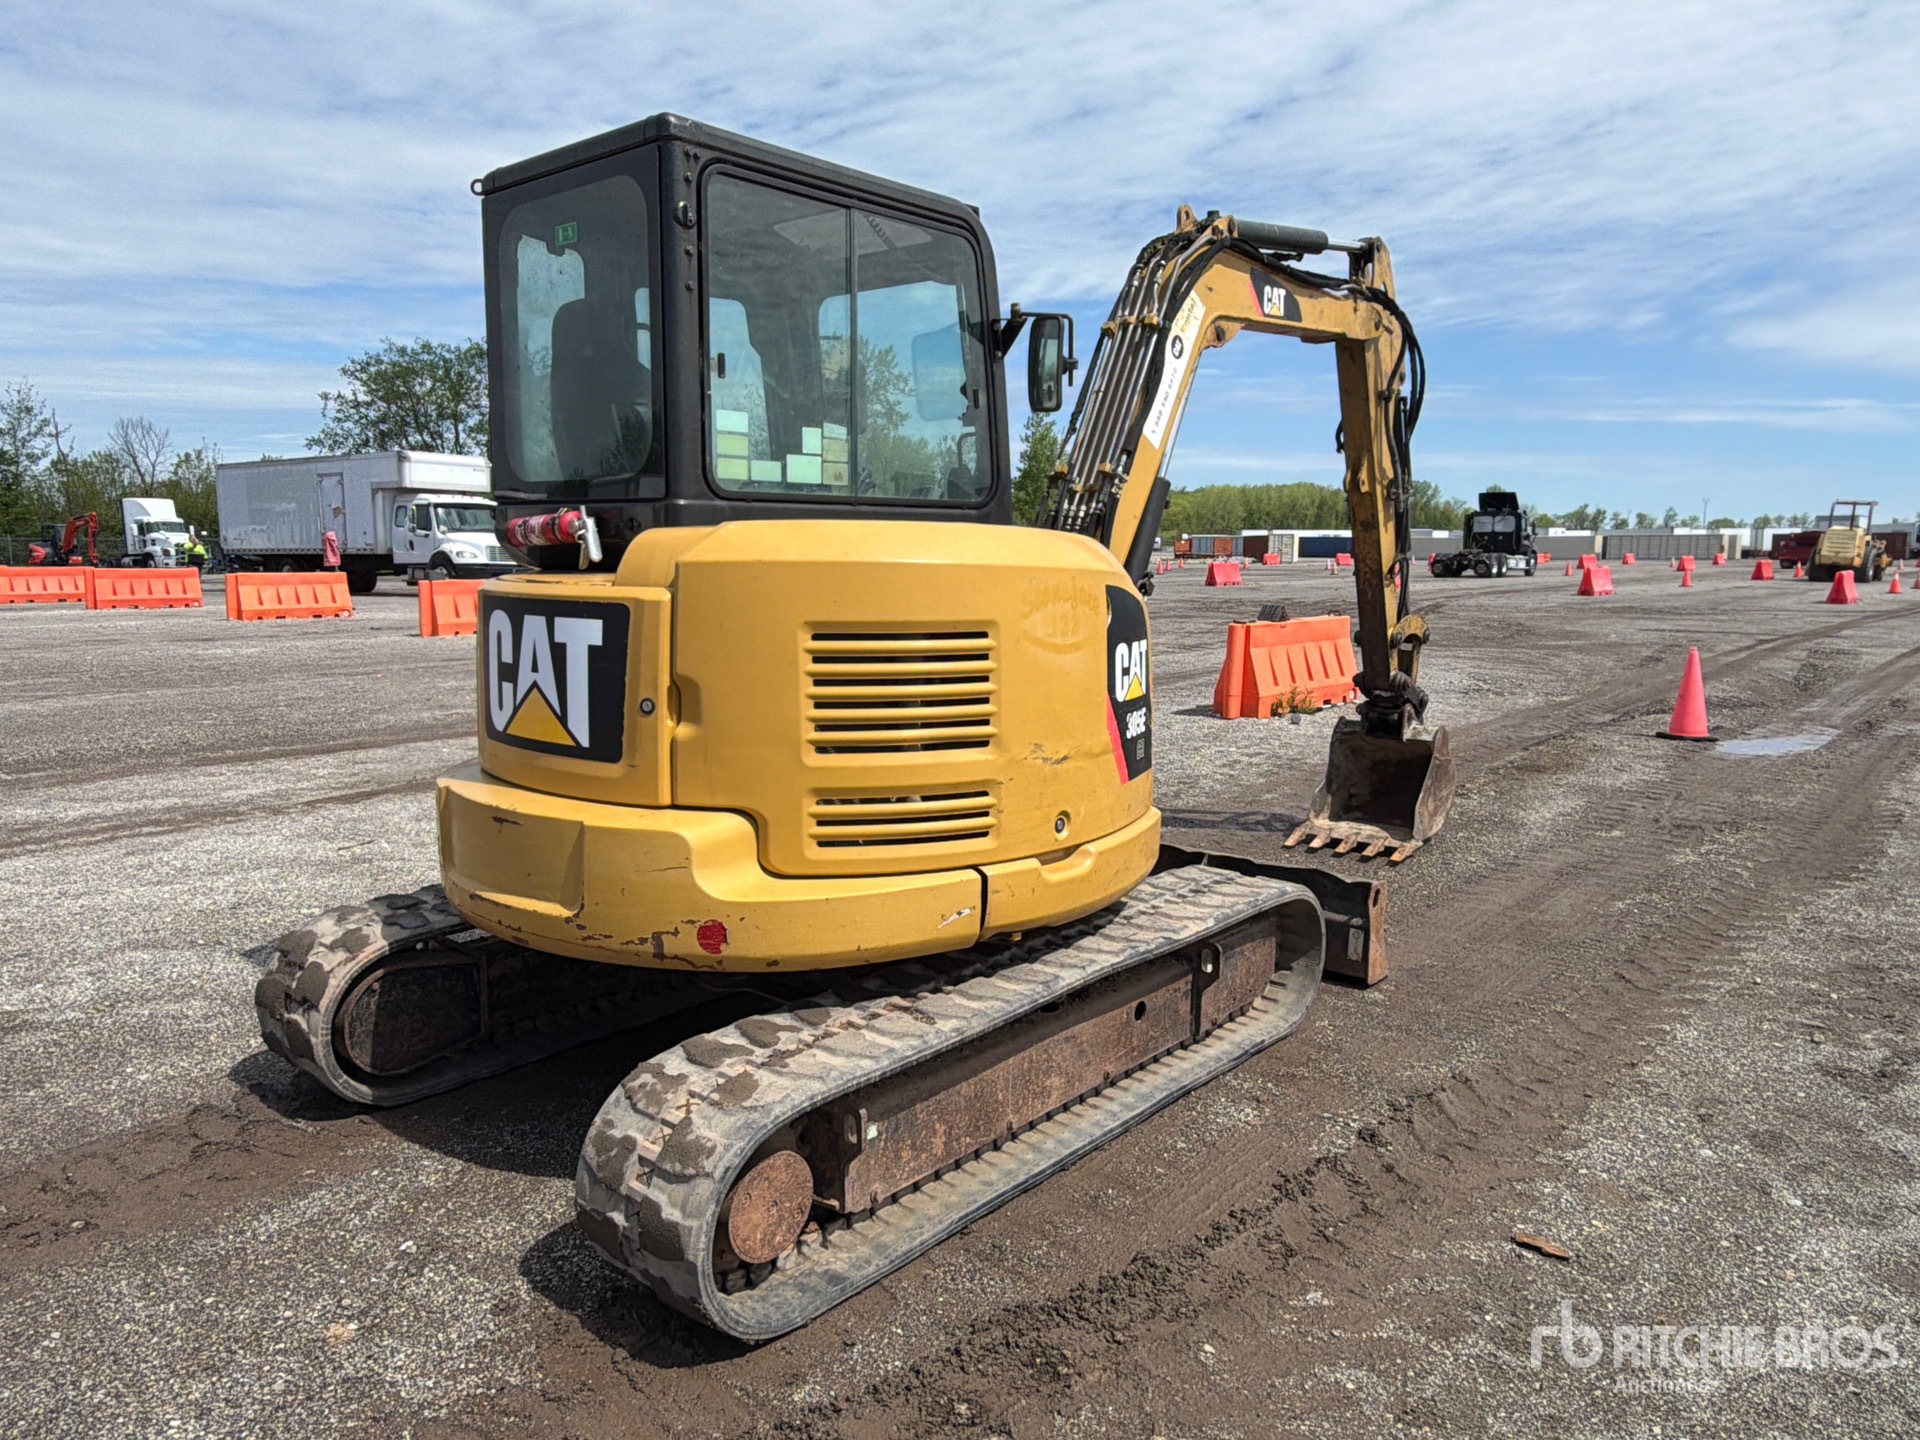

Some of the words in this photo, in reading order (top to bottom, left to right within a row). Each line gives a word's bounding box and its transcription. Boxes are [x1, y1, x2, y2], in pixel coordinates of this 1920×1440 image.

[1263, 285, 1286, 317] CAT
[488, 609, 603, 748] CAT
[1115, 639, 1147, 702] CAT
